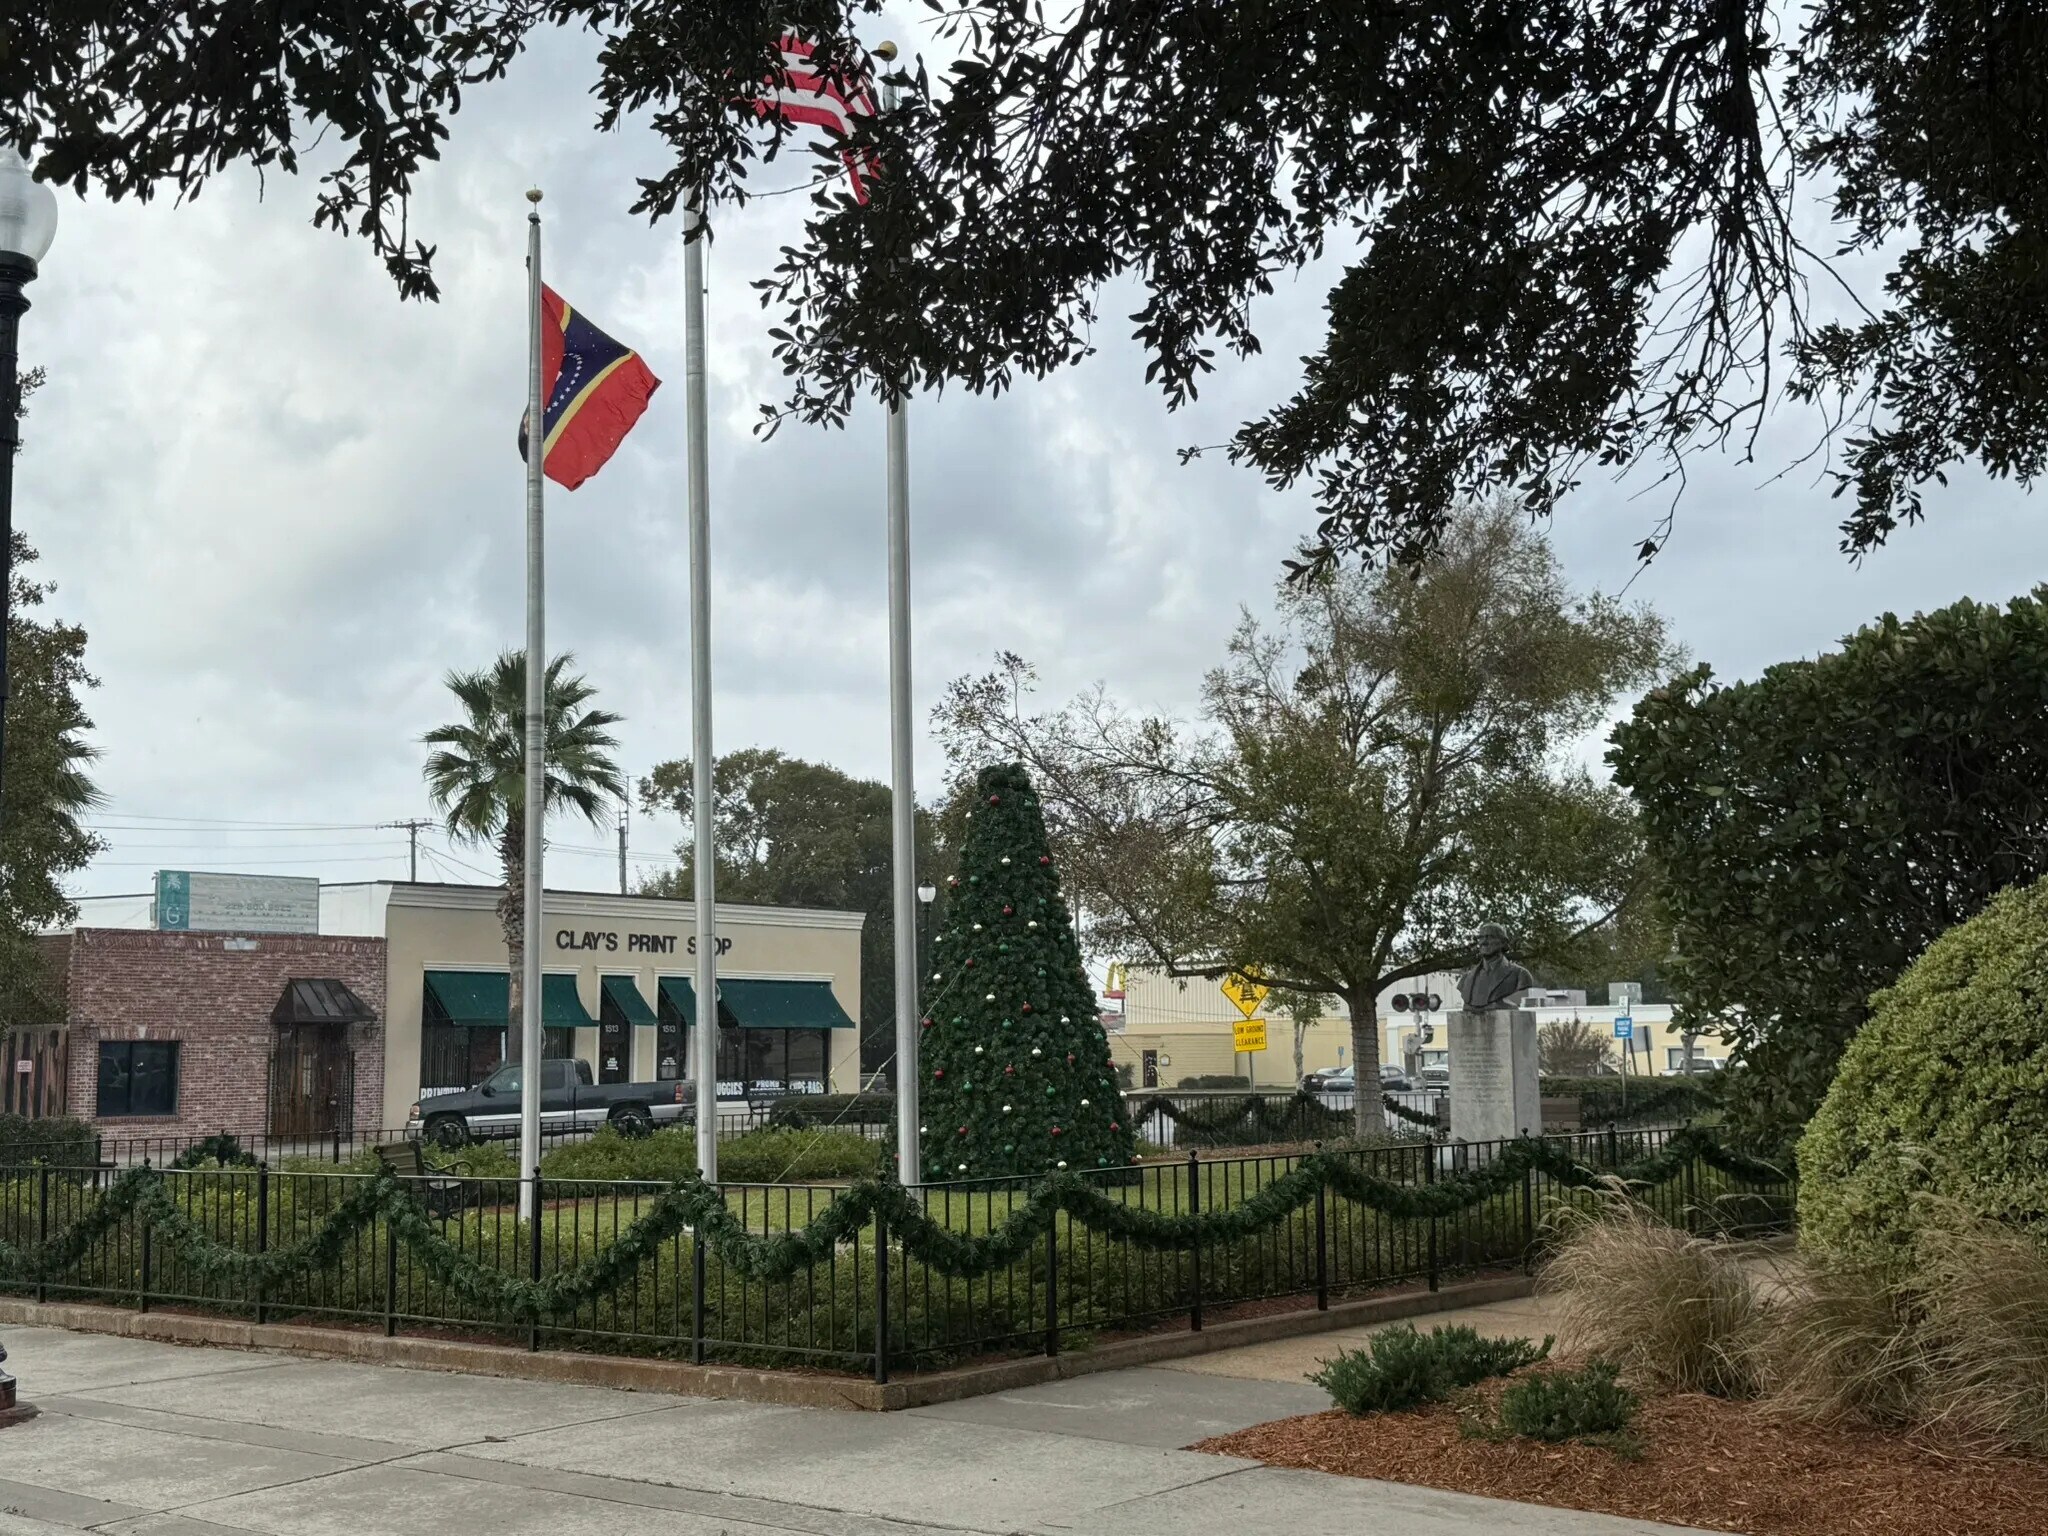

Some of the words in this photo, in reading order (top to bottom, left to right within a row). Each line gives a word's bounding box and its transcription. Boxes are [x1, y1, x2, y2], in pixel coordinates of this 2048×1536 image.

[556, 930, 618, 951] CLAY'S
[628, 934, 677, 953] PRINT
[687, 936, 732, 955] SP
[605, 1024, 619, 1033] 1513
[662, 1025, 676, 1033] 1513
[1236, 1037, 1264, 1046] CLEARANCE
